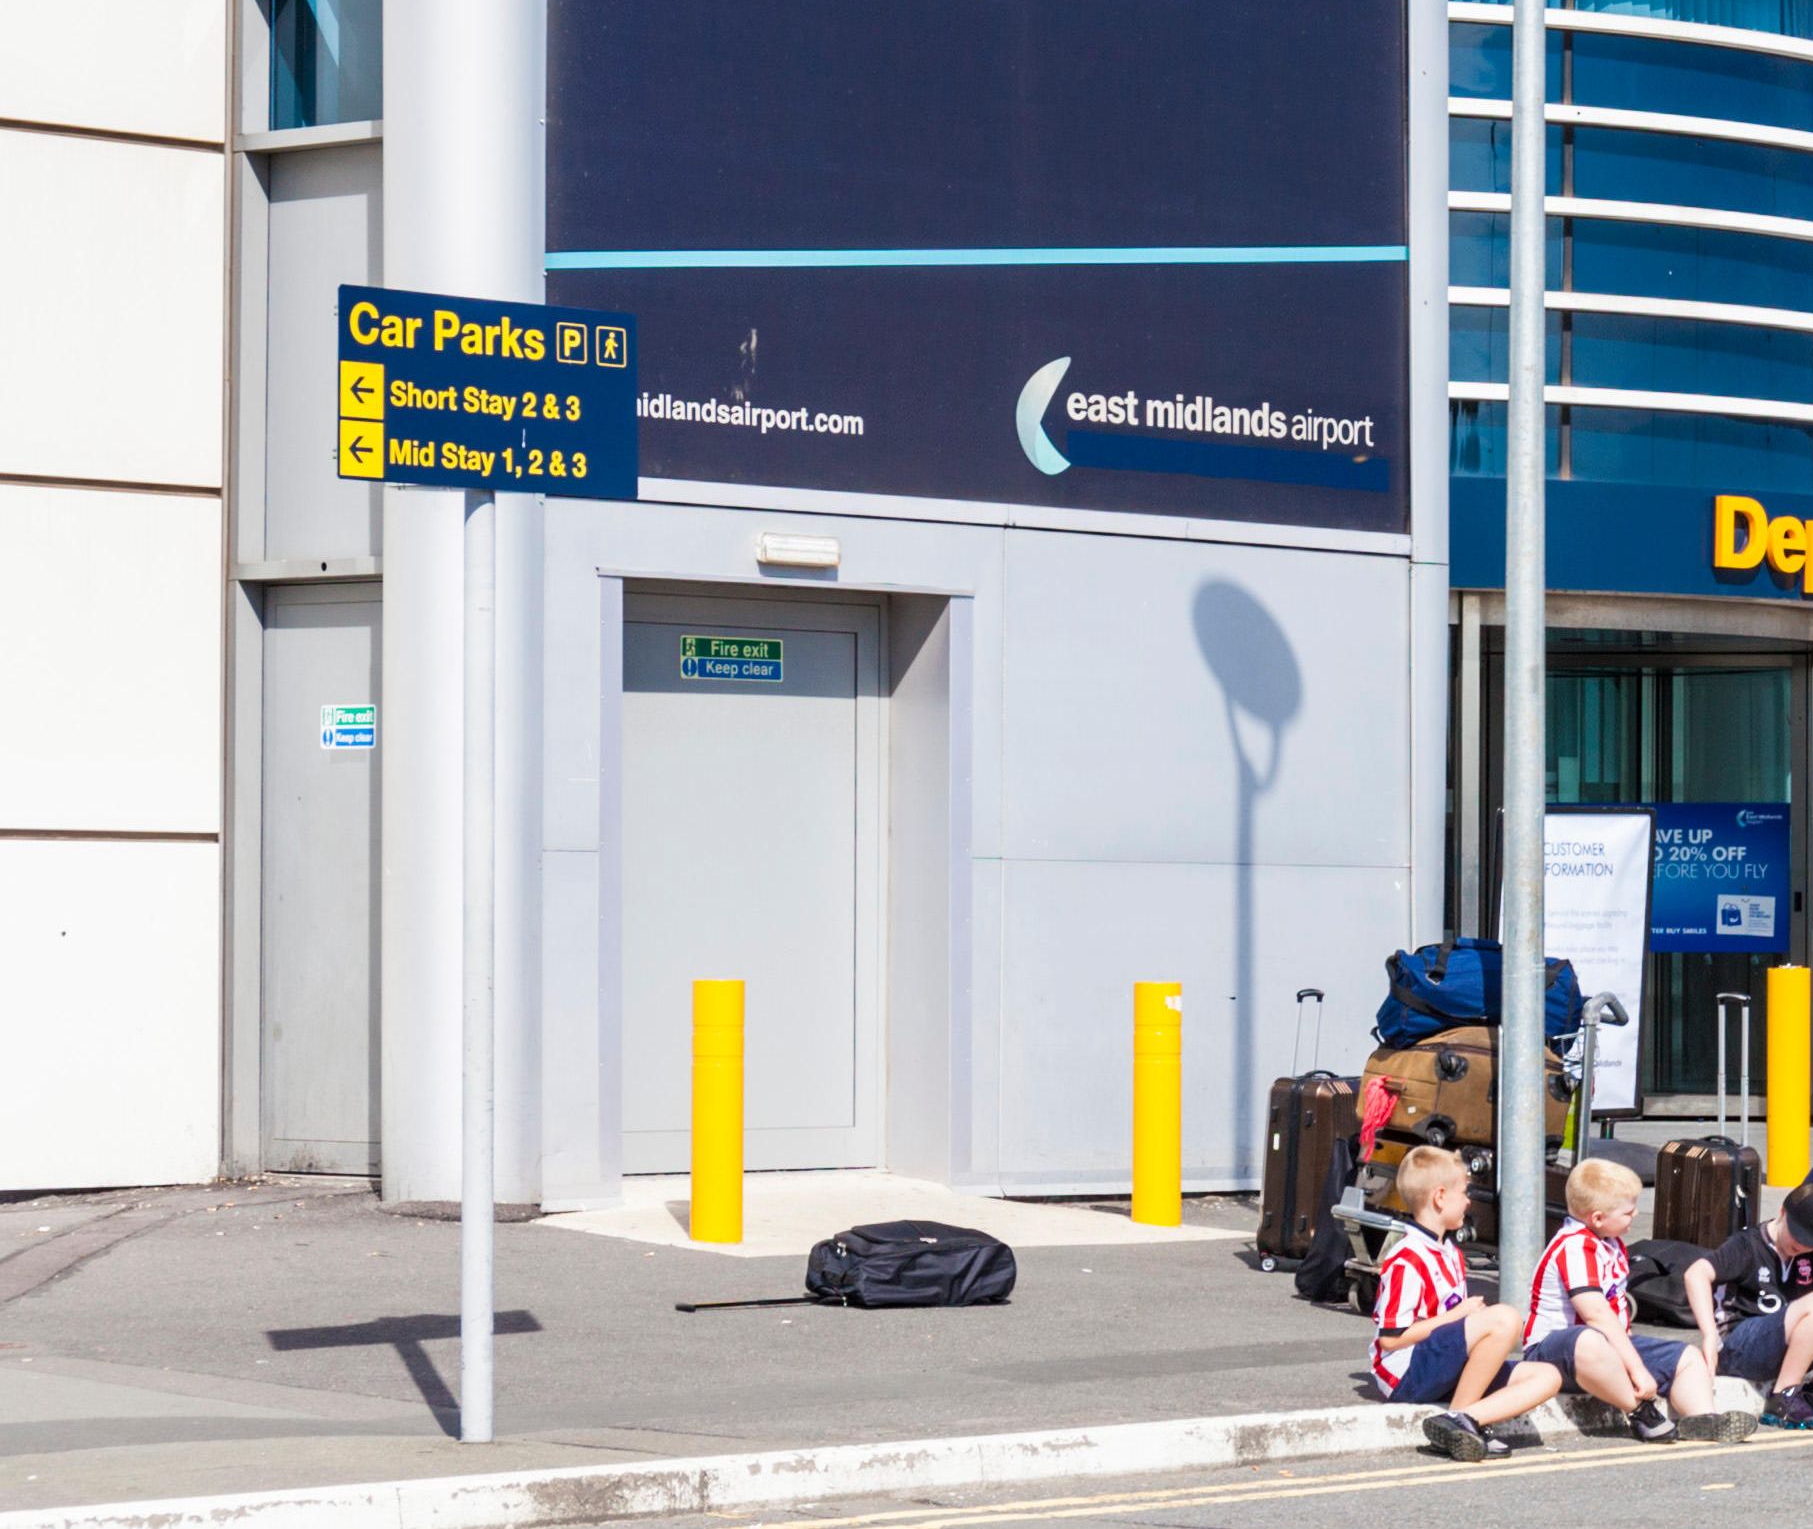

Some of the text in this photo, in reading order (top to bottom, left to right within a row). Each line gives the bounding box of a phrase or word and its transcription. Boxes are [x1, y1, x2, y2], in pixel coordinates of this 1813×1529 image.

[350, 301, 422, 349] Car
[434, 309, 545, 361] Parks
[390, 380, 581, 421] Short Stay 2 & 3
[636, 392, 864, 436] idlandsairport.com
[1066, 390, 1374, 450] east midlands airport
[389, 438, 587, 479] Mid Stay 1, 2 & 3
[711, 640, 769, 658] Fire exit
[706, 660, 774, 678] Keep clear
[1656, 829, 1713, 844] AVE UP
[1544, 842, 1605, 856] CUSTOMER
[1669, 846, 1707, 861] 20%
[1712, 846, 1747, 861] OFF
[1544, 862, 1613, 877] FORMATION
[1654, 863, 1768, 879] FORE YOU FLY
